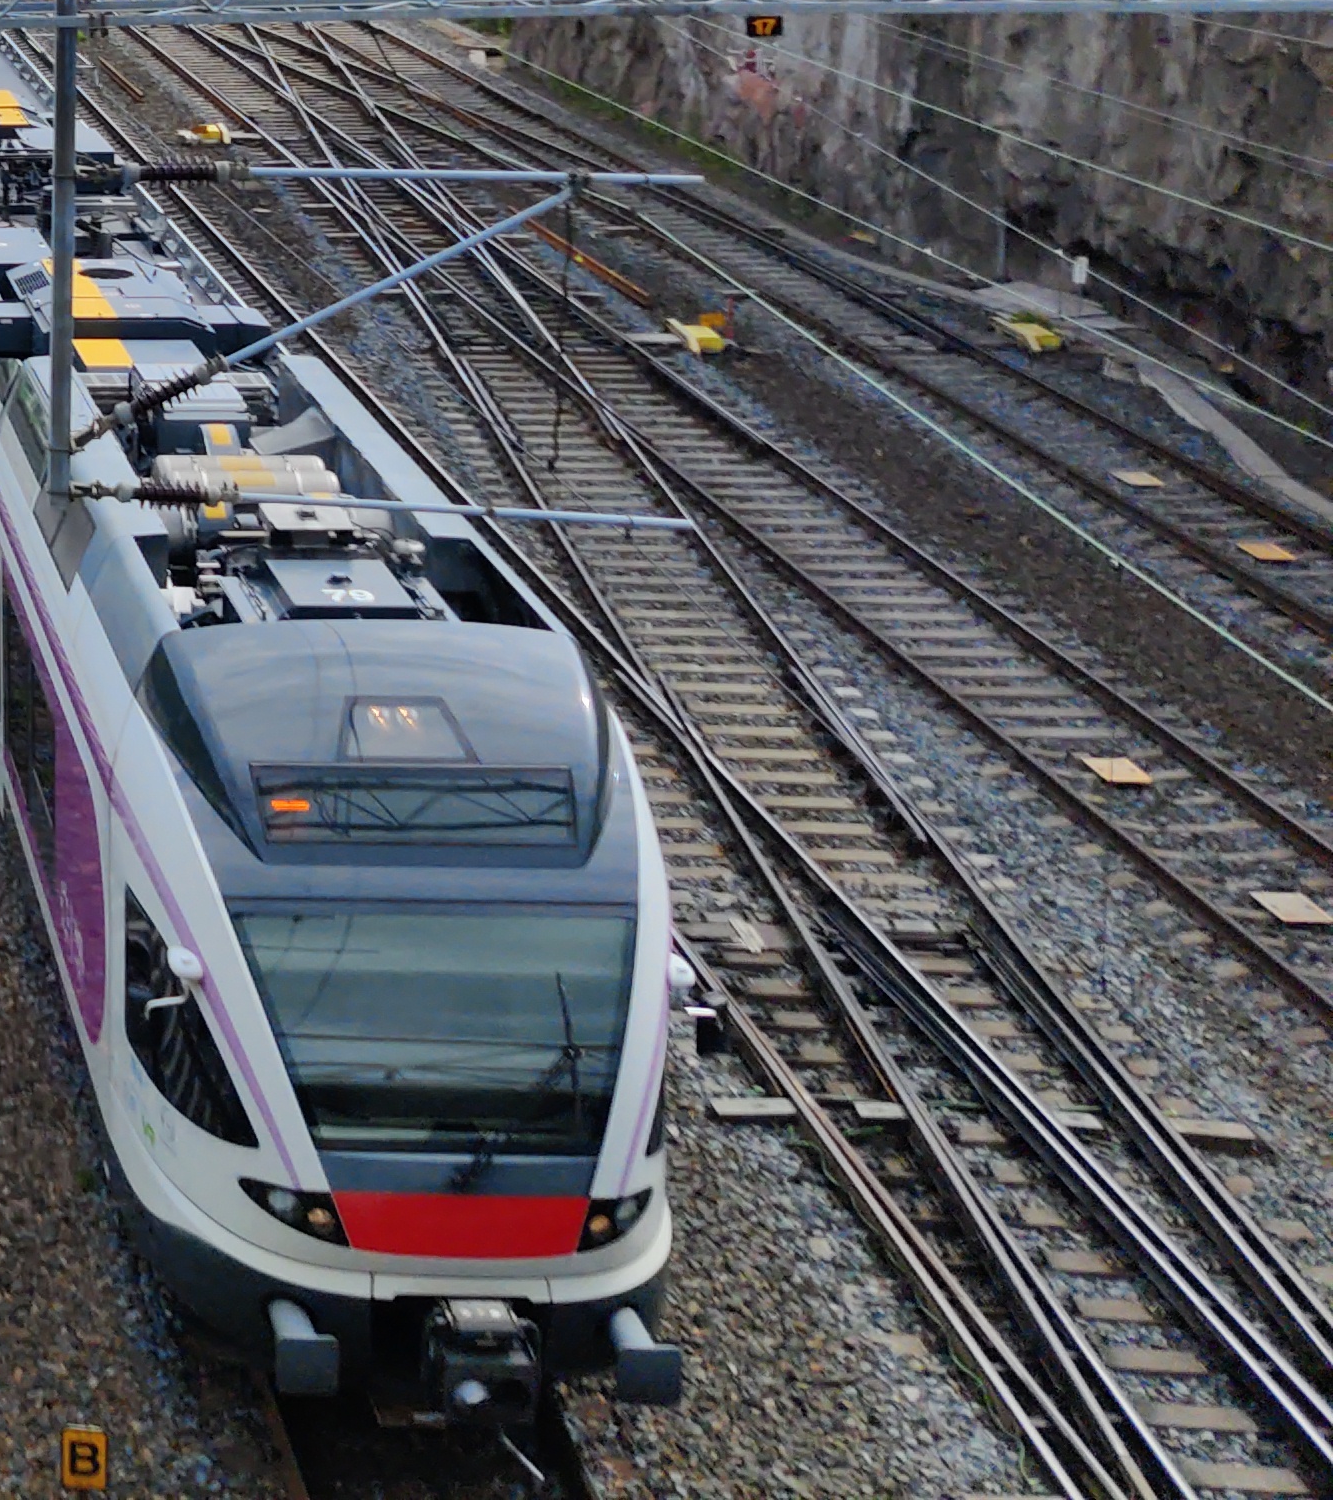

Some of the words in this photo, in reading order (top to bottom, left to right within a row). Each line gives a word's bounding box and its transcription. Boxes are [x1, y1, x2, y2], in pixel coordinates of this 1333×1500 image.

[752, 18, 777, 36] 17
[321, 589, 375, 602] 79
[70, 1442, 100, 1476] B
